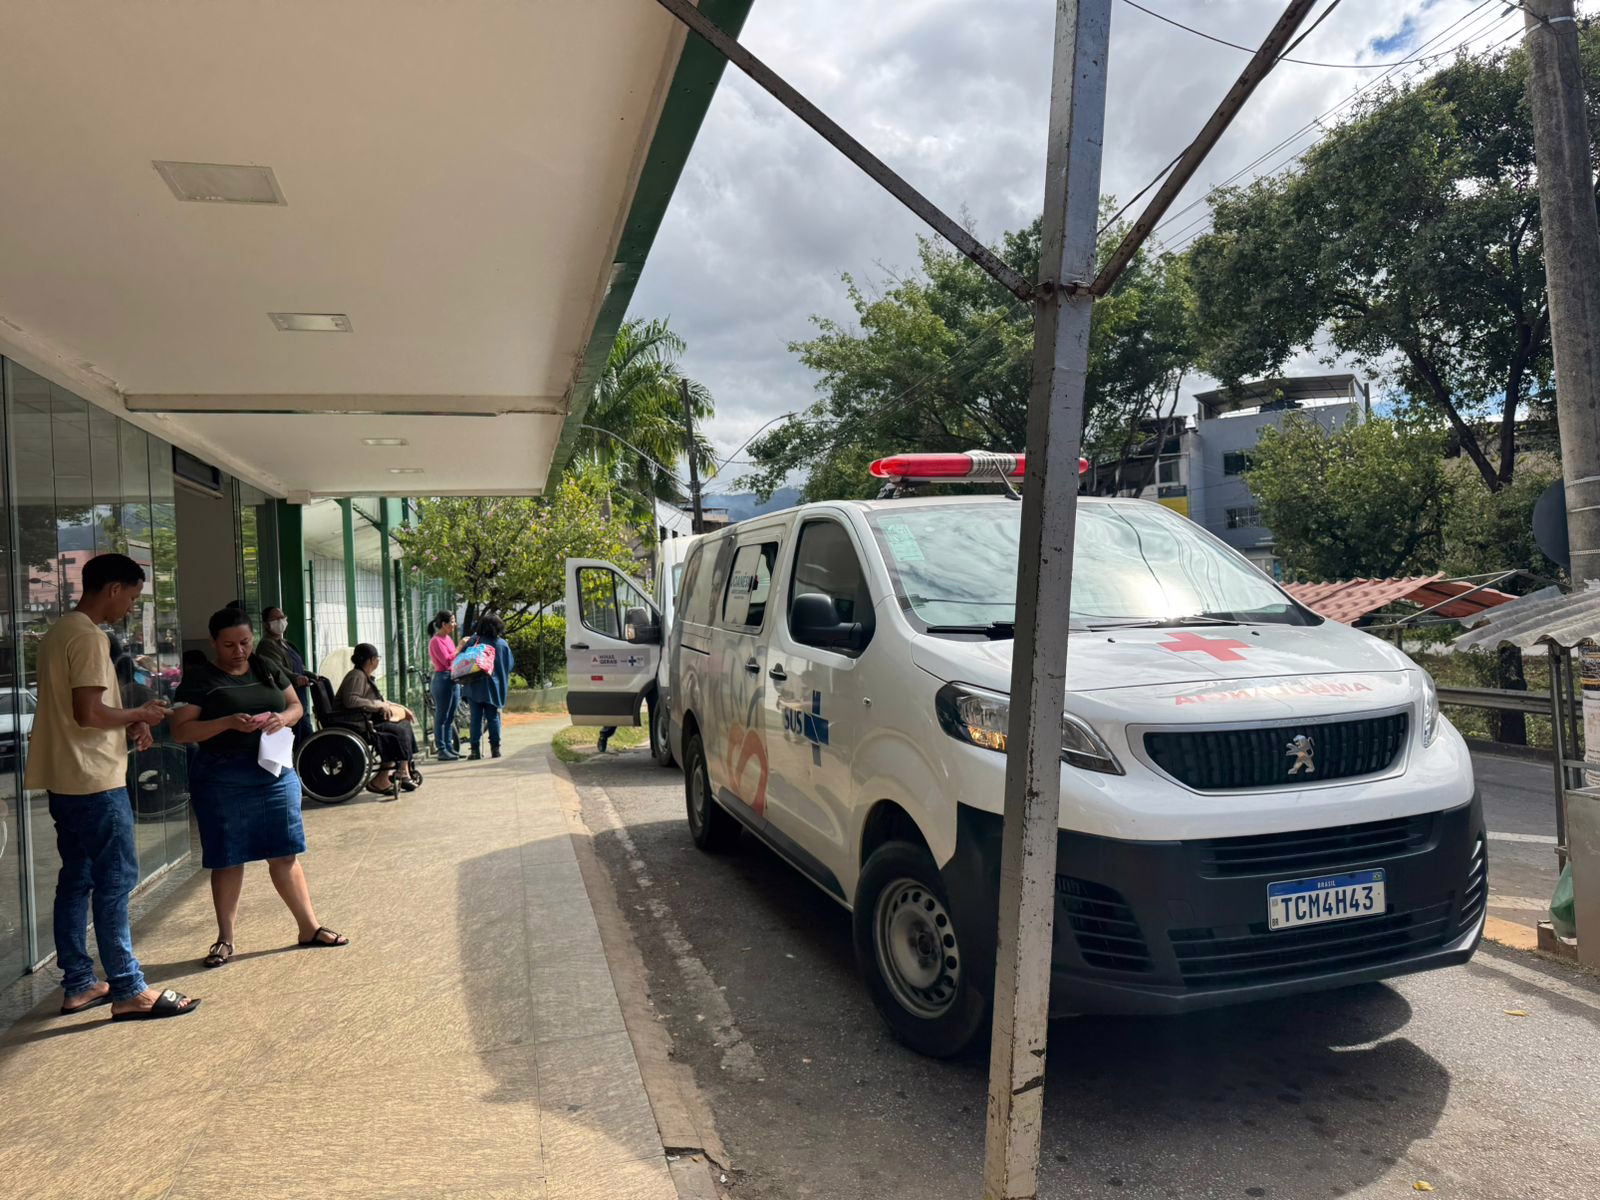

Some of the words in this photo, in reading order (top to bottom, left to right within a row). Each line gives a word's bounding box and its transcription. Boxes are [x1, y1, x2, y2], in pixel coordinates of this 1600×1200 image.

[784, 707, 803, 735] SUS
[1317, 880, 1336, 889] BRASIL
[1281, 886, 1374, 923] TCM4H43
[1271, 917, 1279, 927] BR
